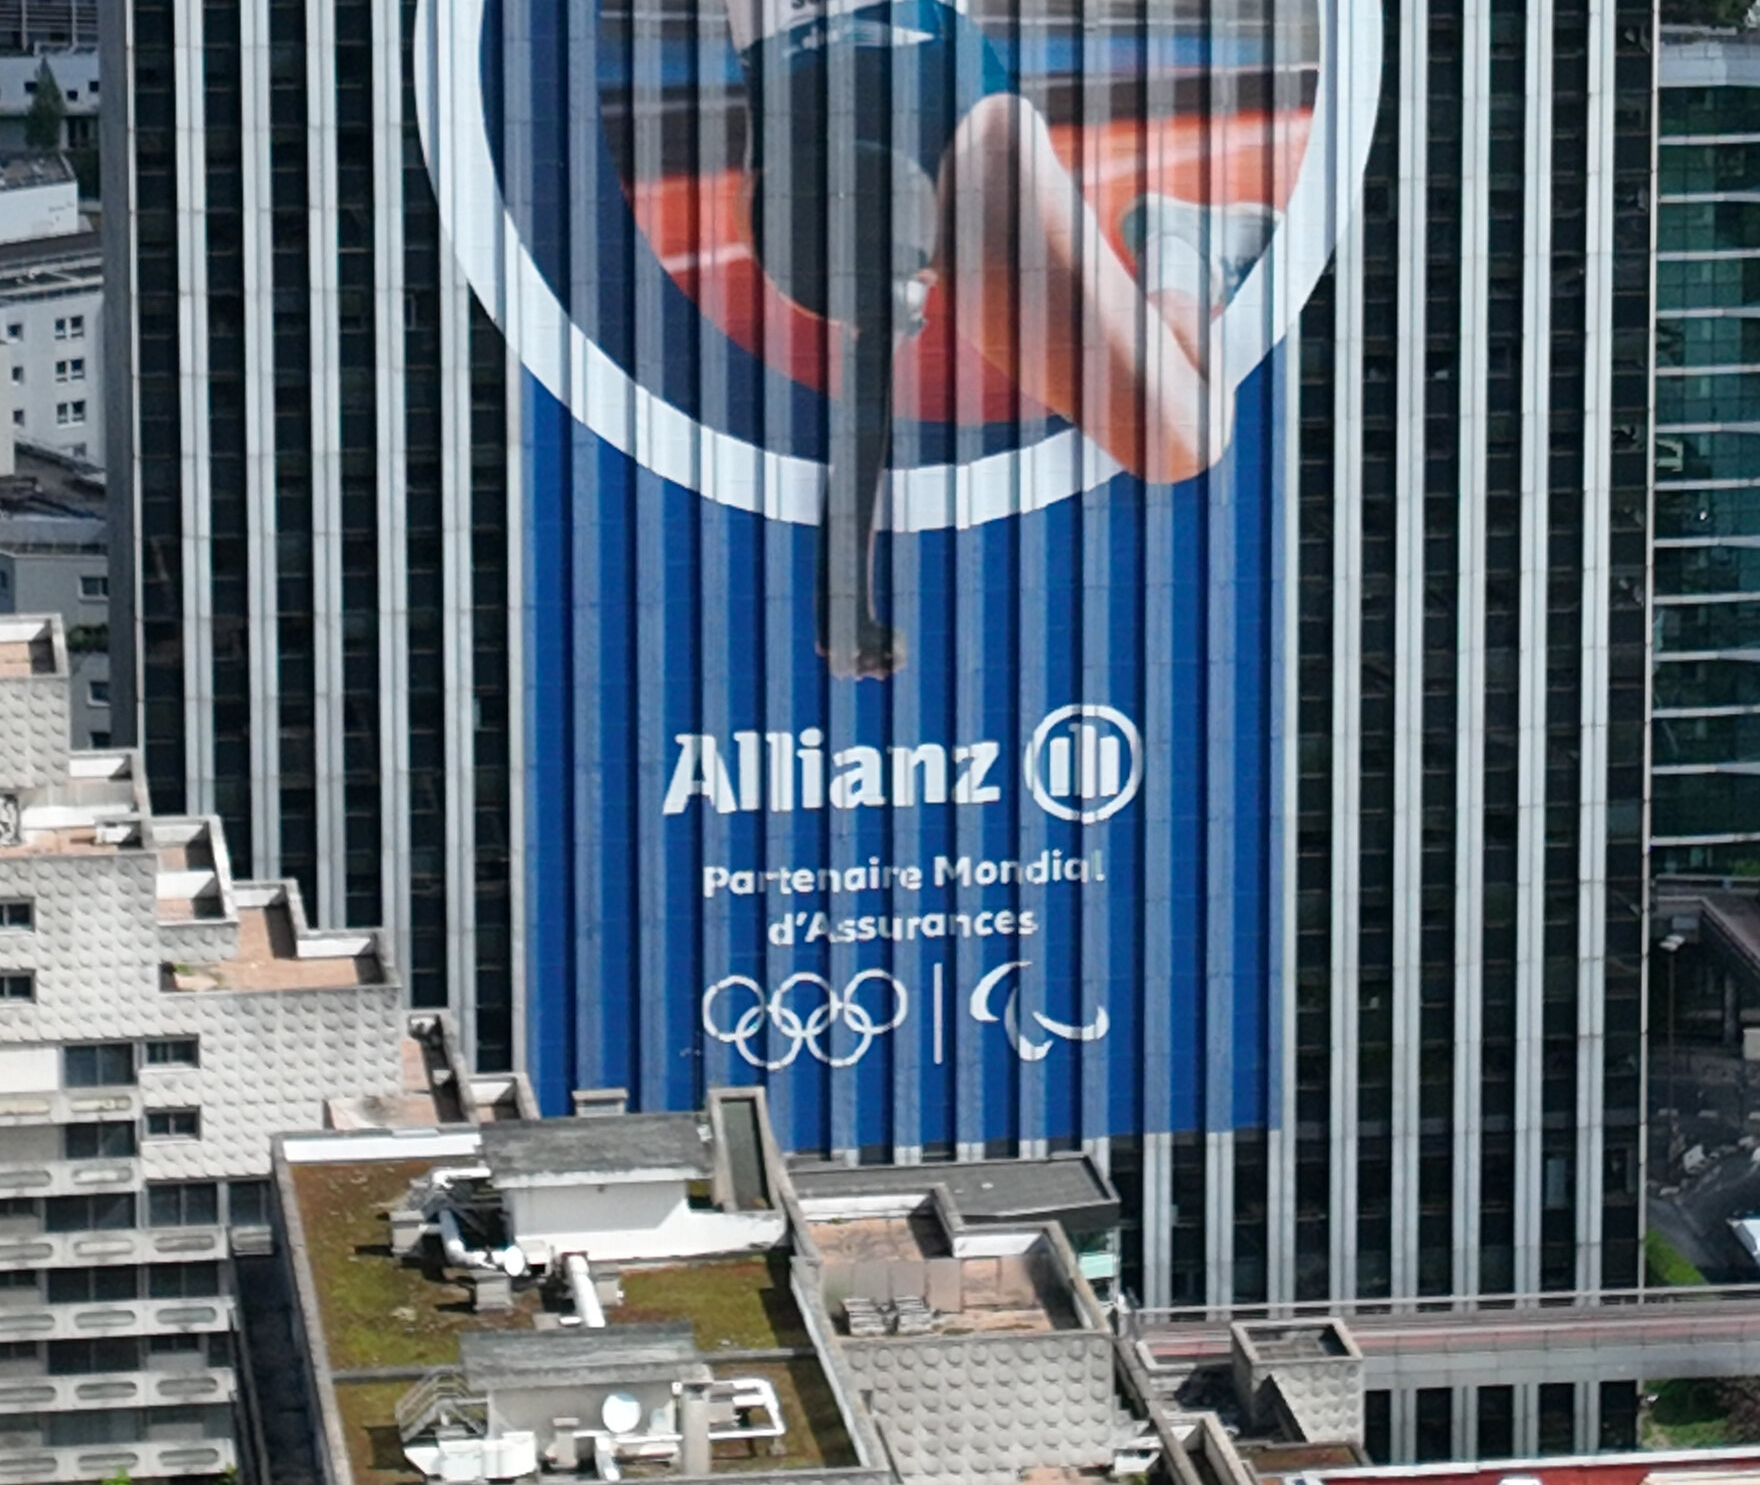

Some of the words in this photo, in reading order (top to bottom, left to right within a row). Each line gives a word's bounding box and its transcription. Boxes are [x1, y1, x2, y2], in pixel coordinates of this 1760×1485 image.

[662, 727, 1001, 815] Allianz
[703, 856, 922, 898] Partenaire
[767, 909, 1038, 946] d’Assurances
